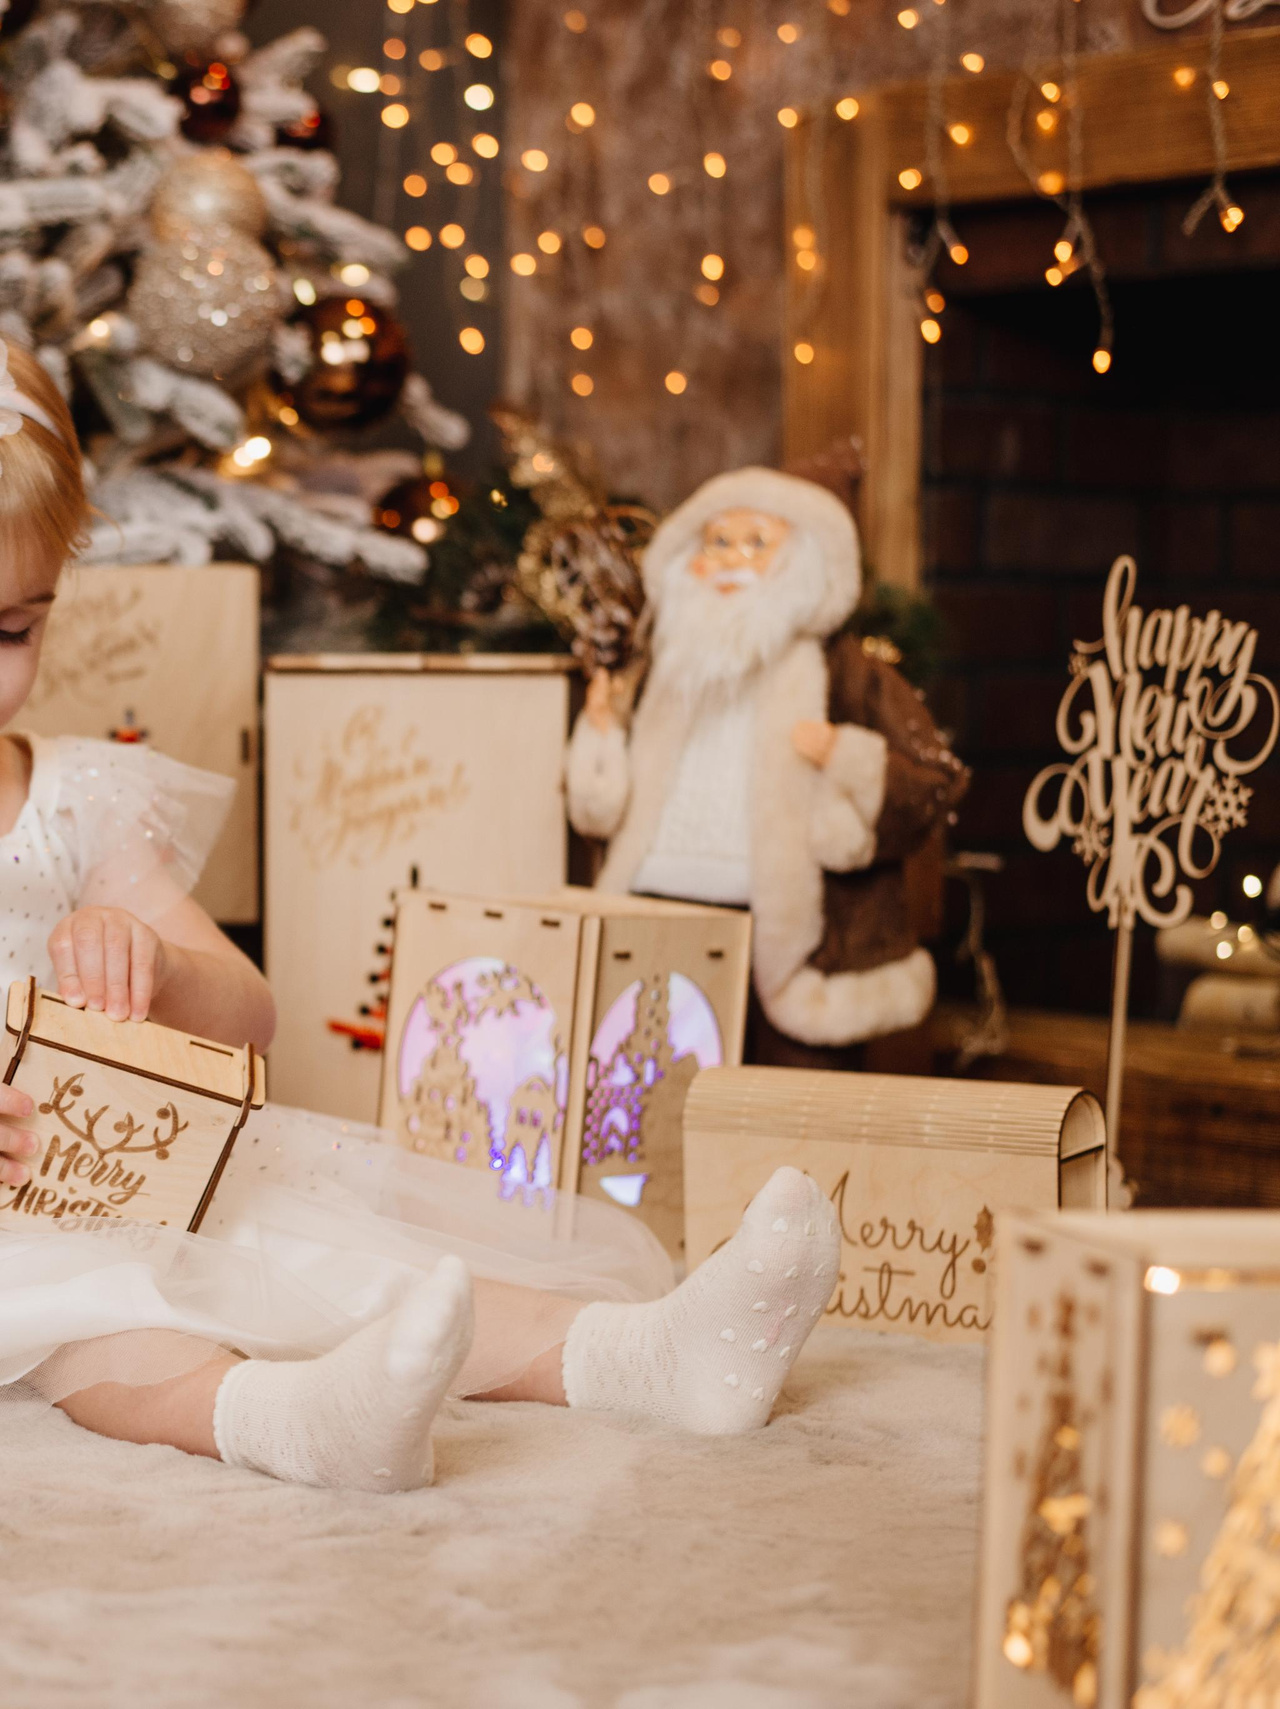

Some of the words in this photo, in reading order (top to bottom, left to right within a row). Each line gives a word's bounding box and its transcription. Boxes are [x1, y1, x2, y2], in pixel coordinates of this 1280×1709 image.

[1056, 660, 1258, 768] New
[39, 1134, 151, 1205] Merry
[825, 1261, 993, 1331] istma
